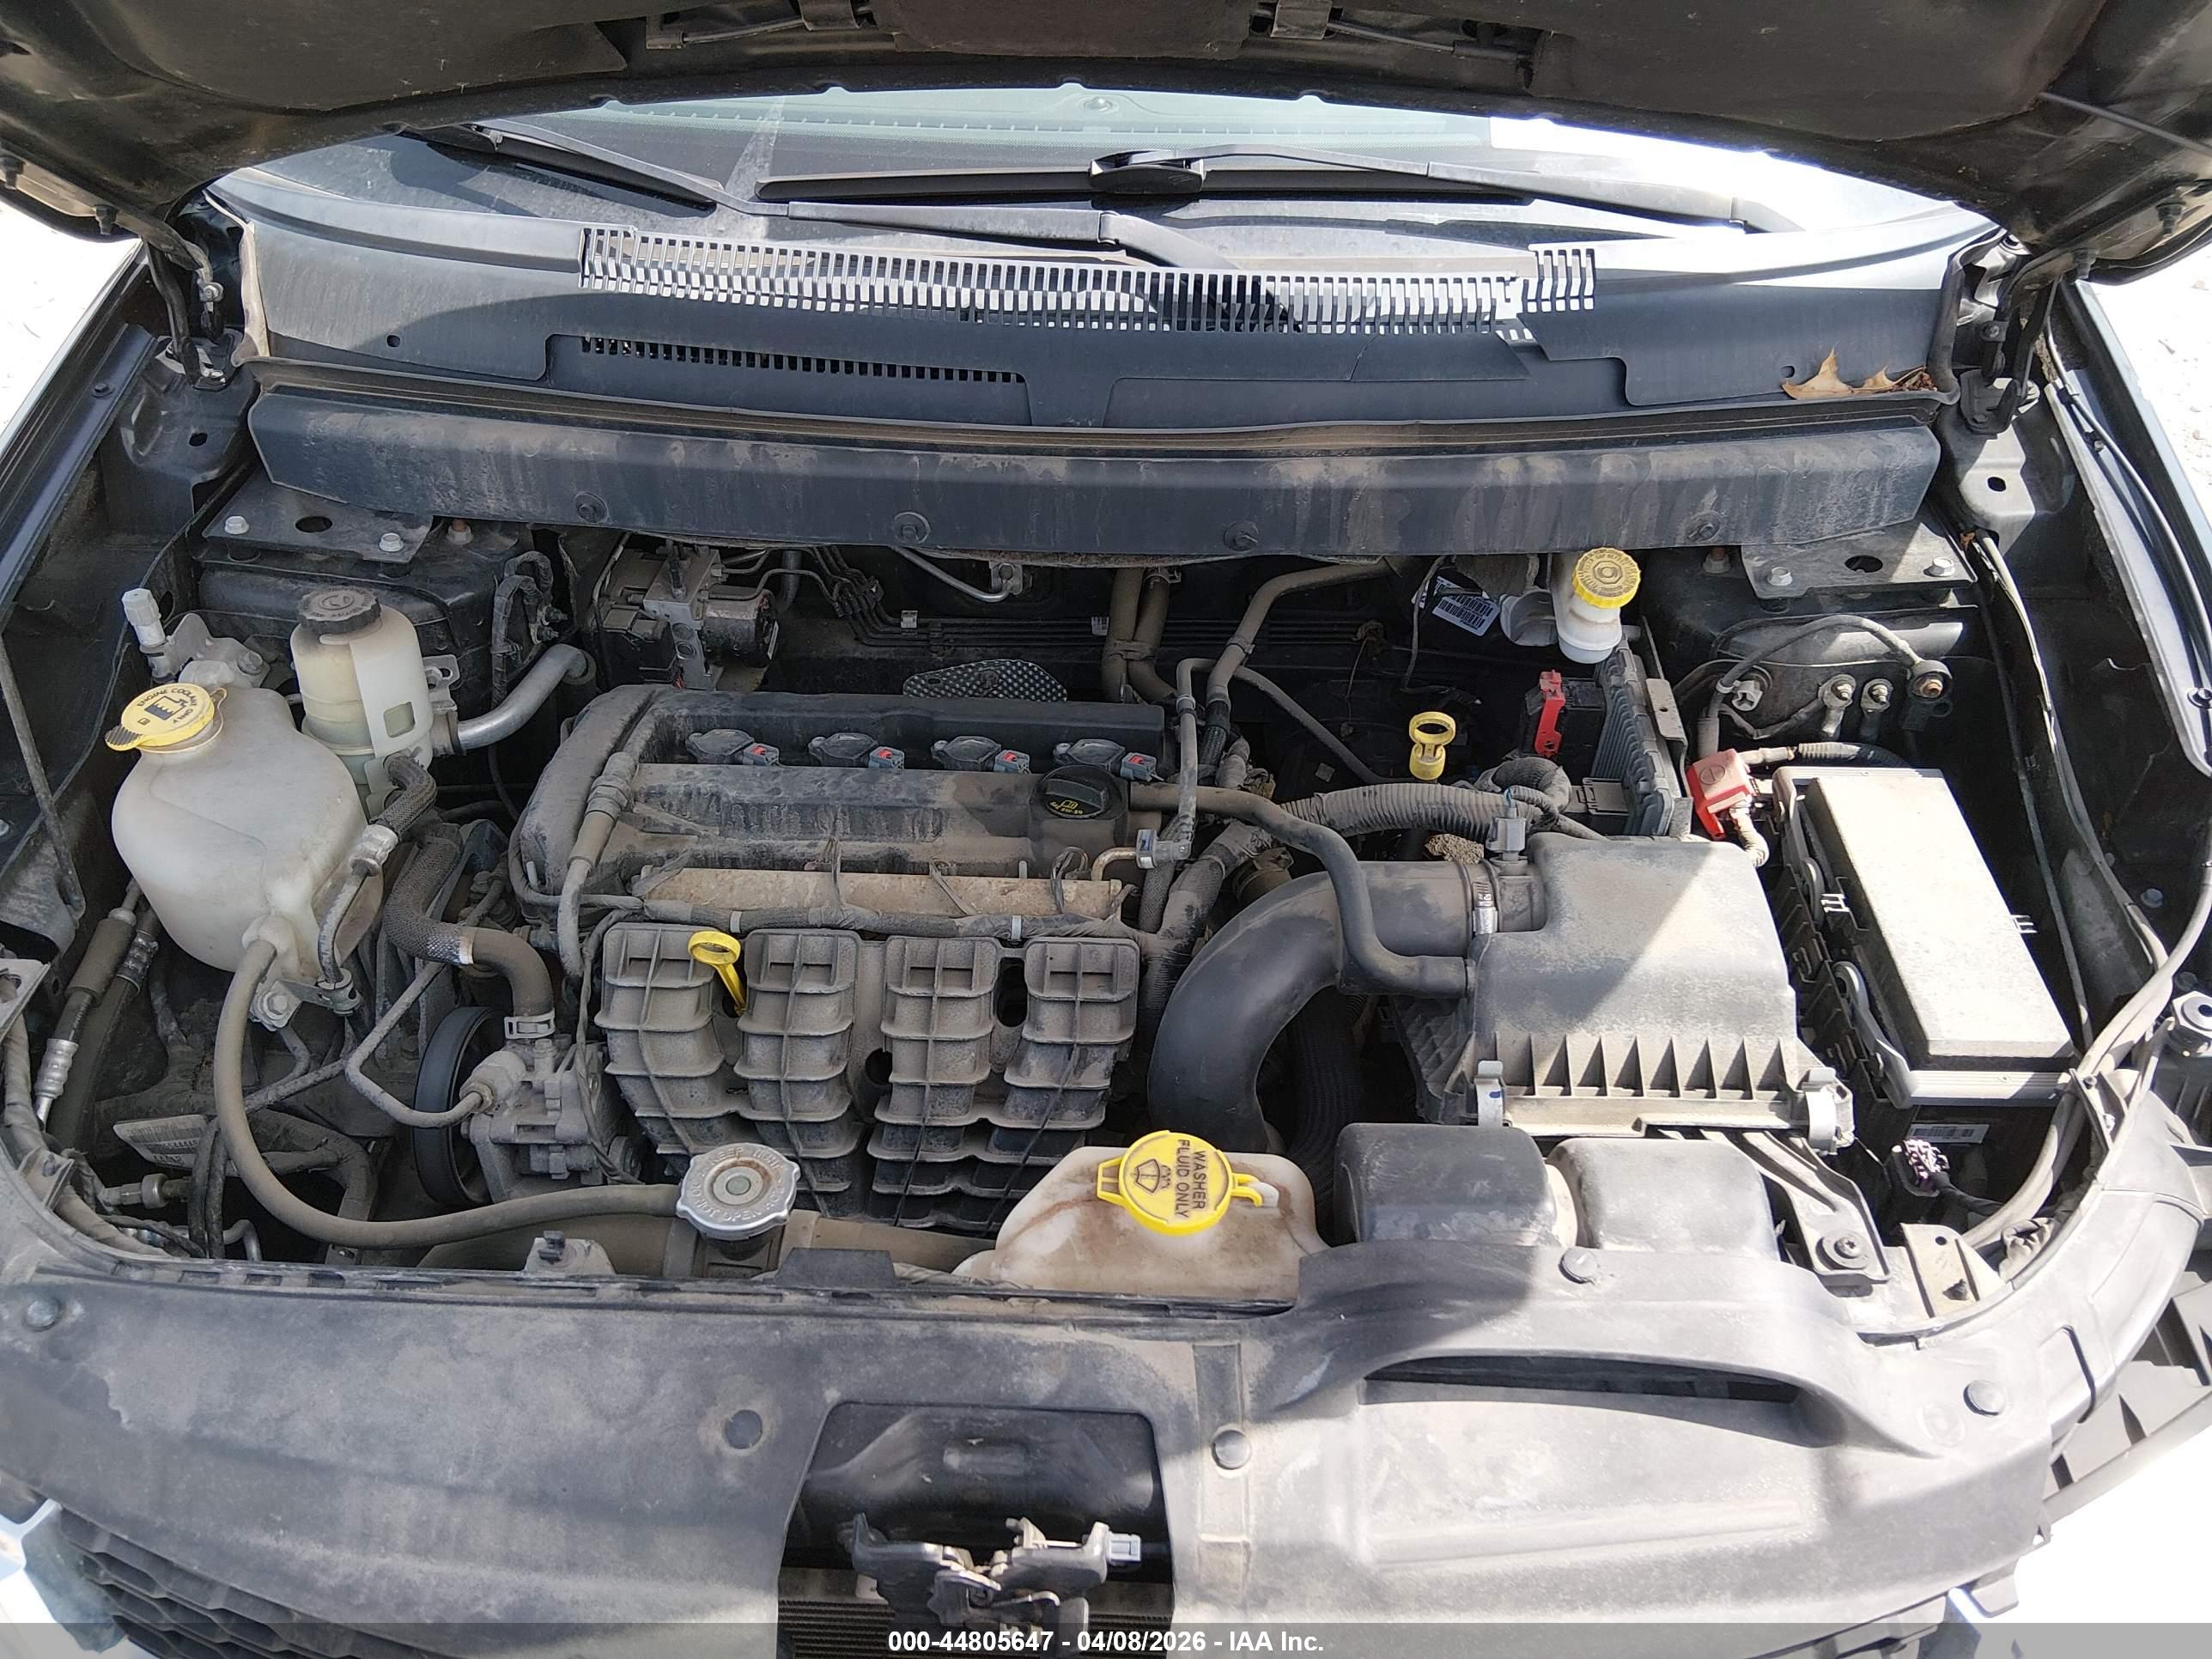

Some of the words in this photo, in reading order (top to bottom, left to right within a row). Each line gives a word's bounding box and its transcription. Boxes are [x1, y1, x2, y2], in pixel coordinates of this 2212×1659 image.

[137, 688, 167, 707] ENGINE
[172, 687, 198, 707] COOLANT
[173, 708, 193, 724] ONLY
[1175, 1139, 1191, 1178] FLUID
[1191, 1150, 1208, 1211] WASHER
[694, 1199, 721, 1218] NOT
[723, 1209, 763, 1222] OPEN
[1174, 1182, 1190, 1218] ONLY
